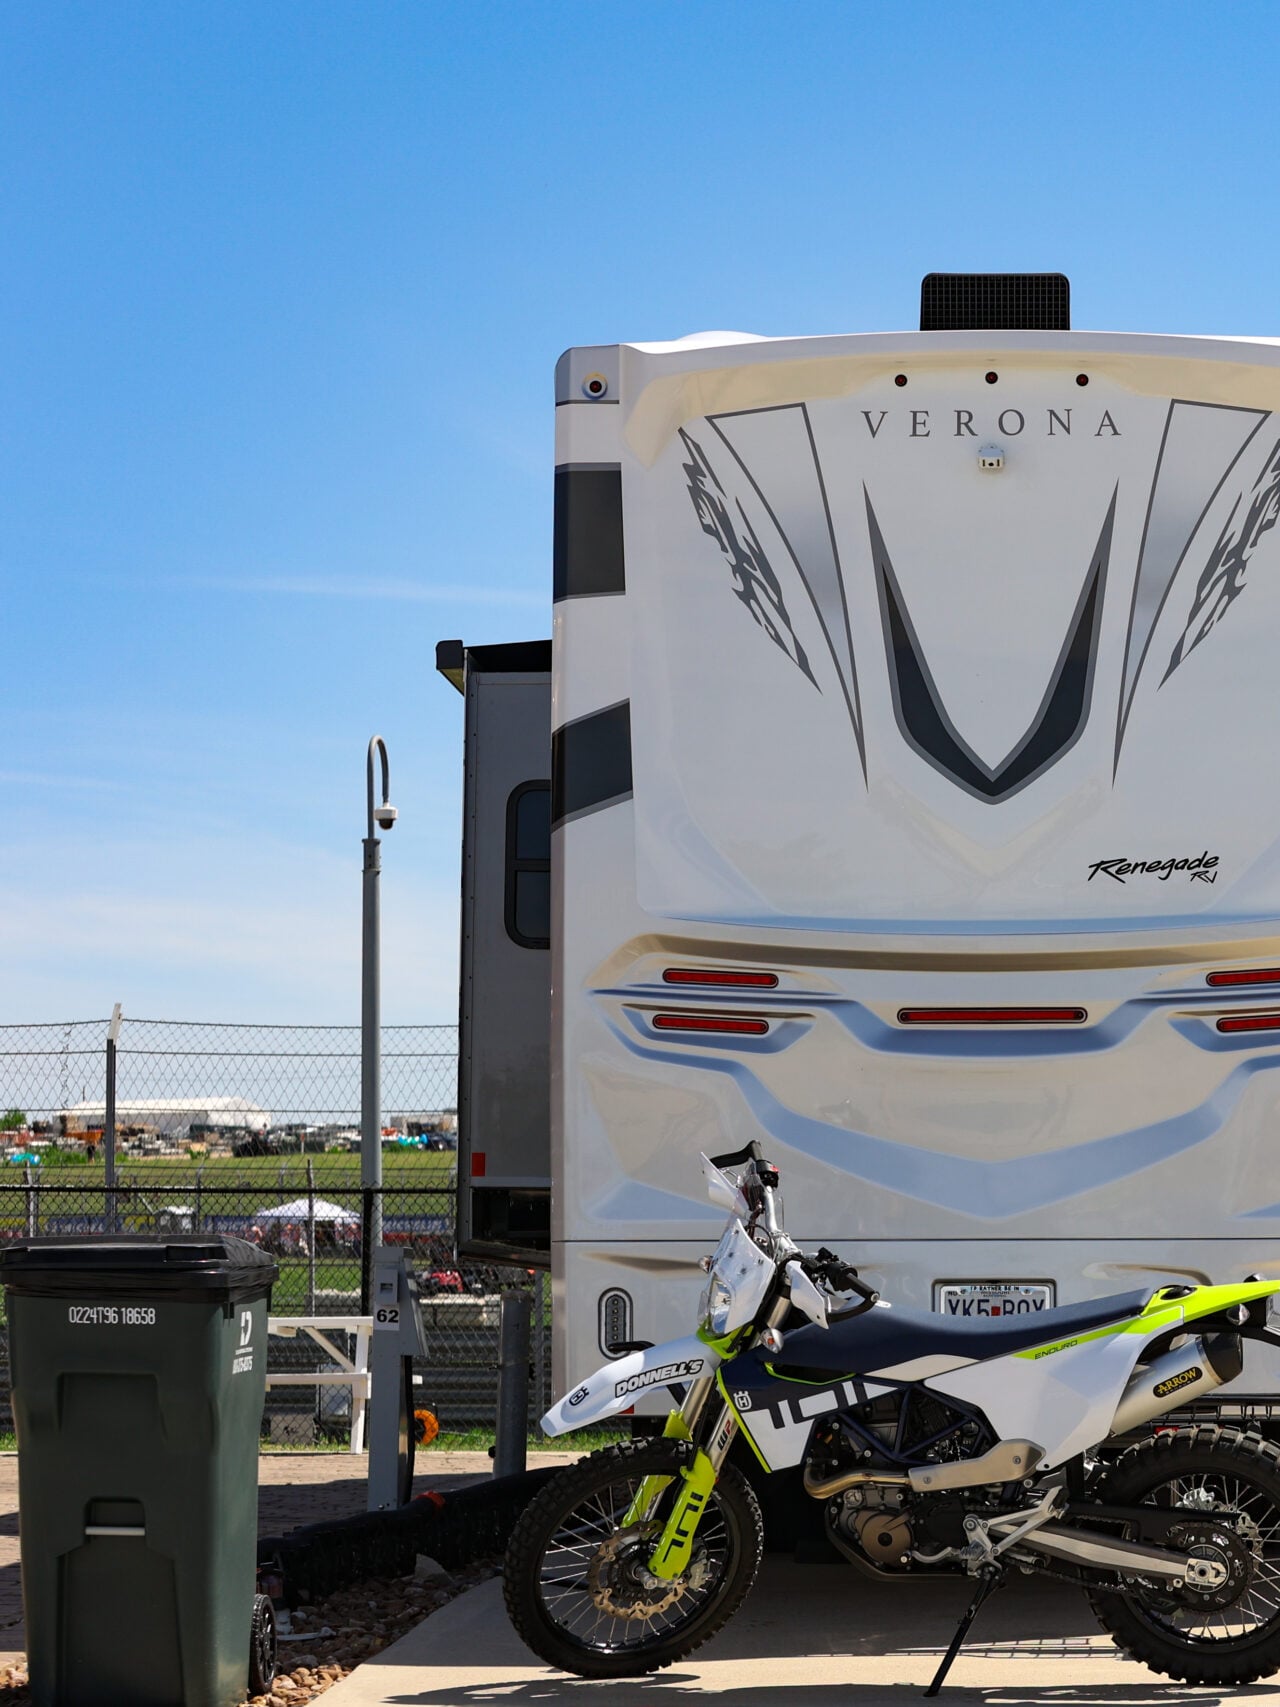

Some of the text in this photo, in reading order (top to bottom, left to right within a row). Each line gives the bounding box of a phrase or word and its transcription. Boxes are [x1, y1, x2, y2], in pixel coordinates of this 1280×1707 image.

[860, 409, 1122, 439] VERONA
[1088, 850, 1220, 884] Renegade
[1190, 870, 1218, 884] RV
[68, 1306, 156, 1325] 0224T96 18658
[376, 1308, 399, 1323] 62
[1034, 1339, 1078, 1360] ENDURO
[615, 1359, 704, 1398] DONNELL'S
[1157, 1368, 1197, 1395] ARROW
